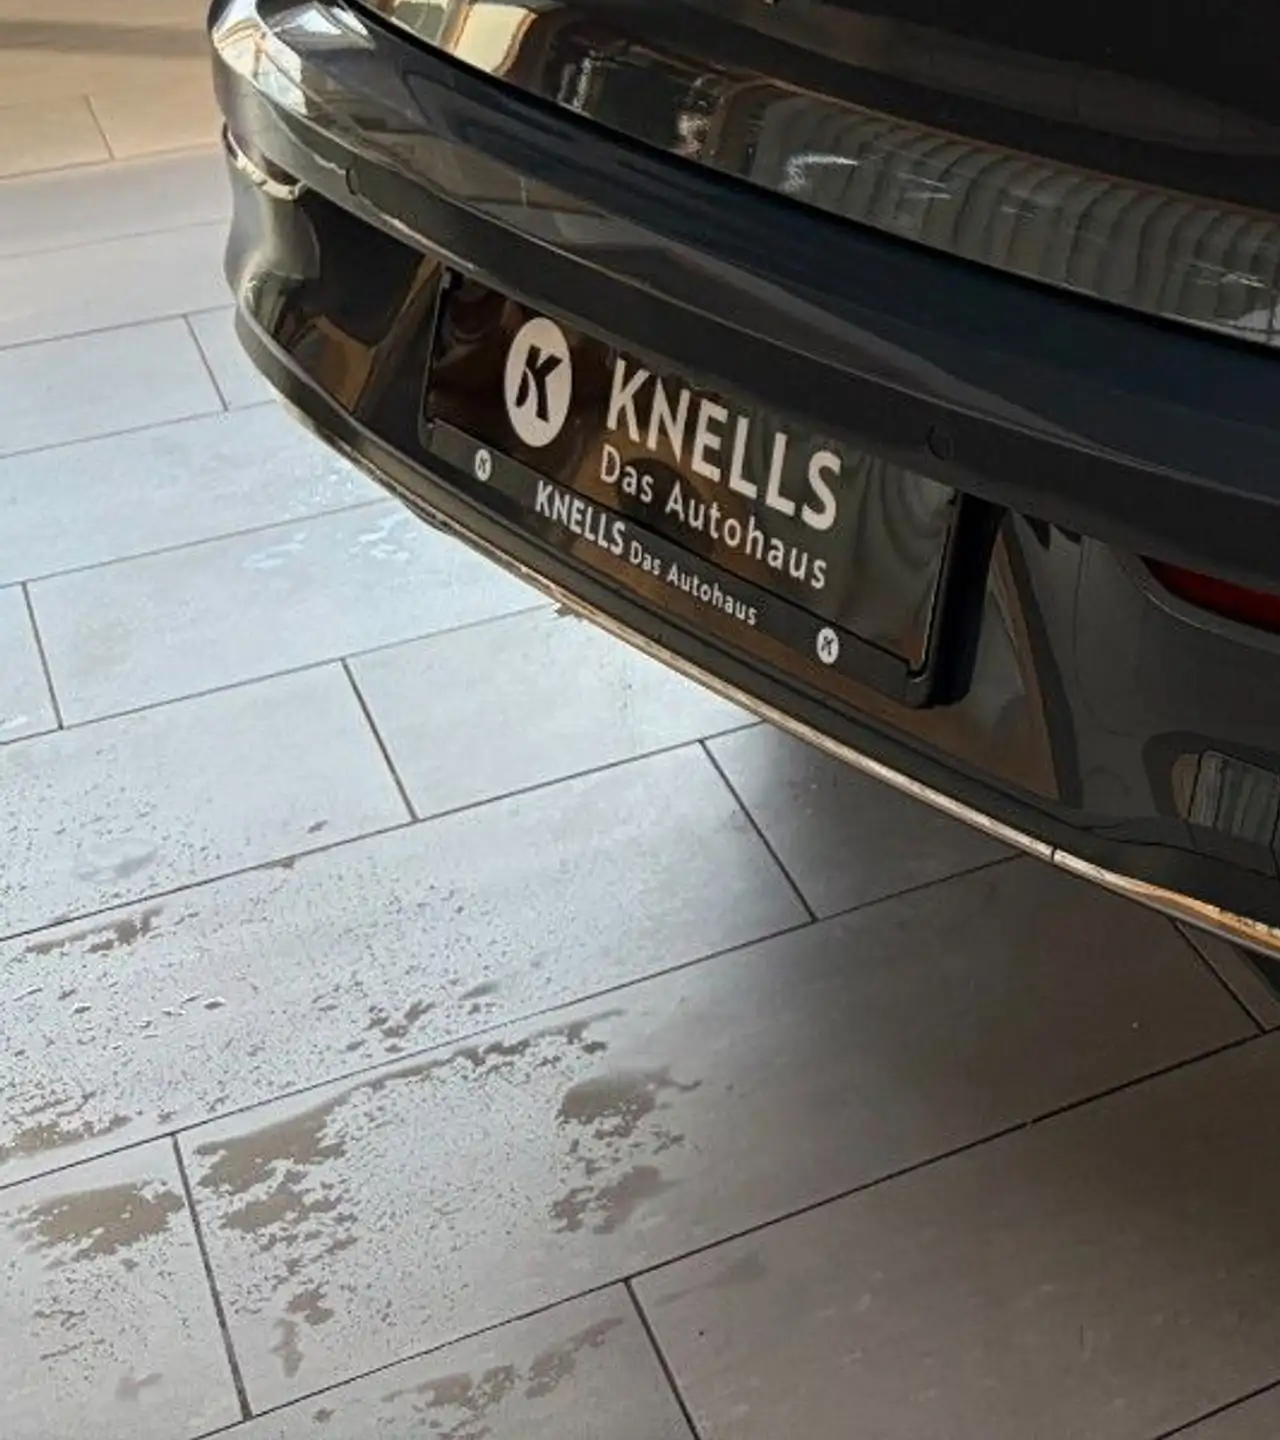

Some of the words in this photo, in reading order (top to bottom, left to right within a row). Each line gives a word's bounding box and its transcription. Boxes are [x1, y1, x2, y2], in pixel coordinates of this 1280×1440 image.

[600, 443, 655, 503] Das
[665, 479, 828, 590] Autohaus
[605, 356, 843, 531] KNELLS
[535, 479, 626, 556] KNELLS
[629, 540, 662, 577] Das
[666, 563, 758, 626] Autohaus
